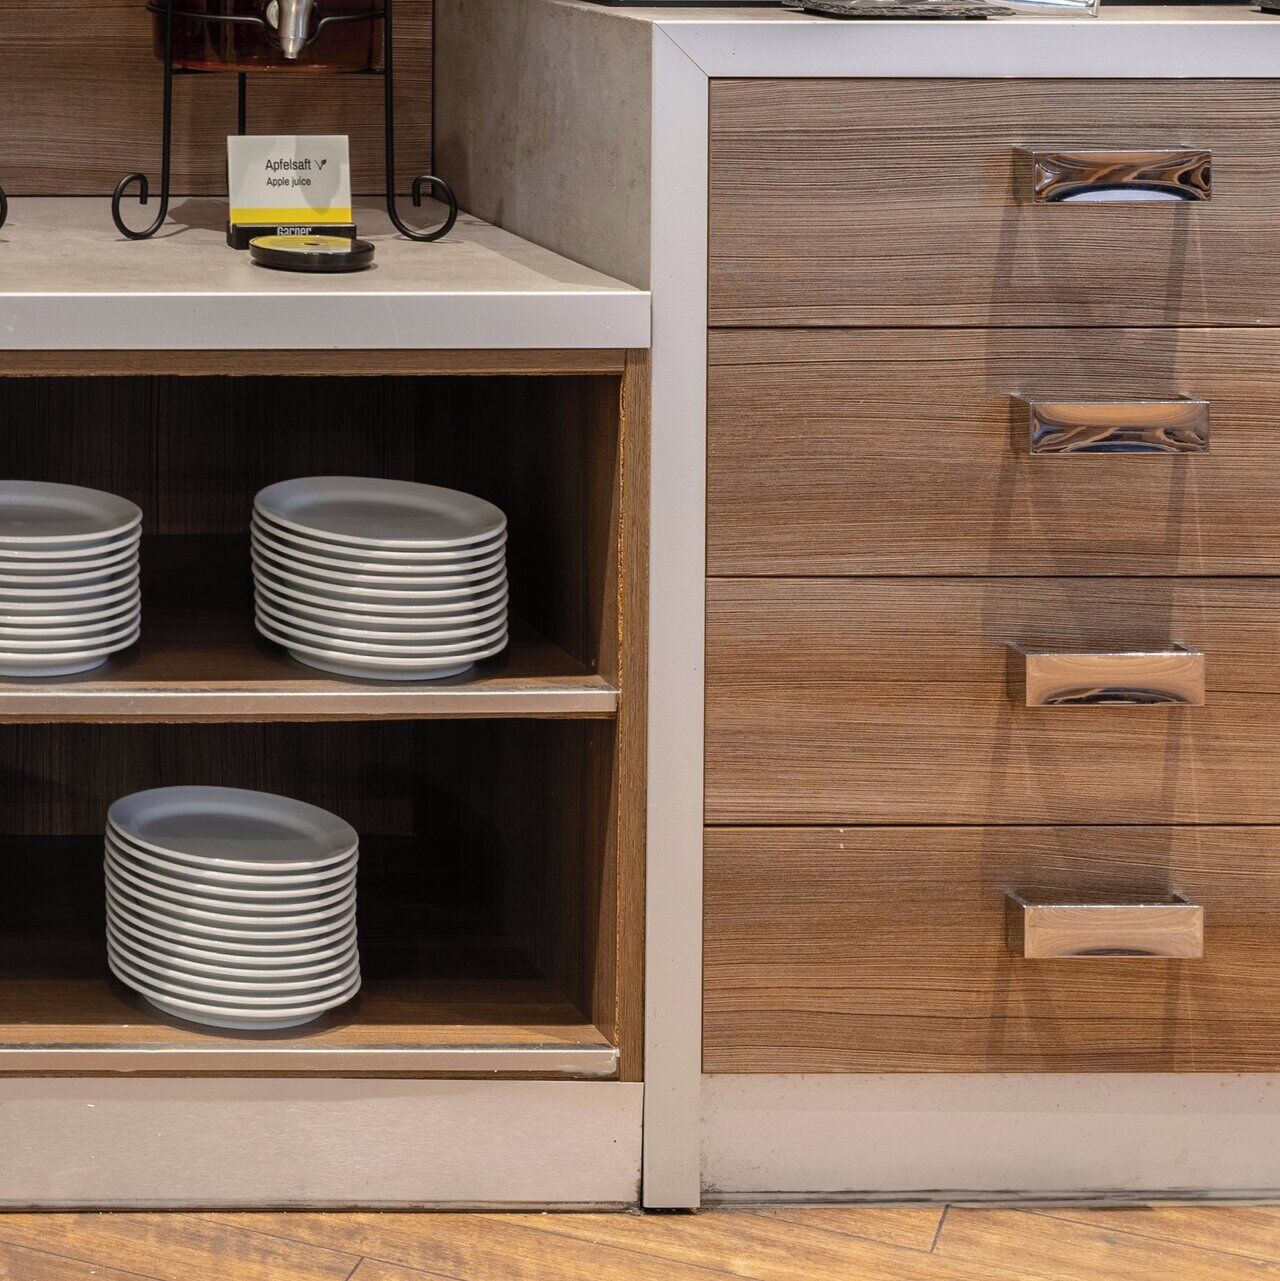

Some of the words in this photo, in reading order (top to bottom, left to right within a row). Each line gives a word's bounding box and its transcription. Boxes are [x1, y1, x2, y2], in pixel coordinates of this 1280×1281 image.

[265, 158, 312, 172] Apfelsaft
[266, 177, 290, 188] Apple
[291, 177, 312, 188] juice
